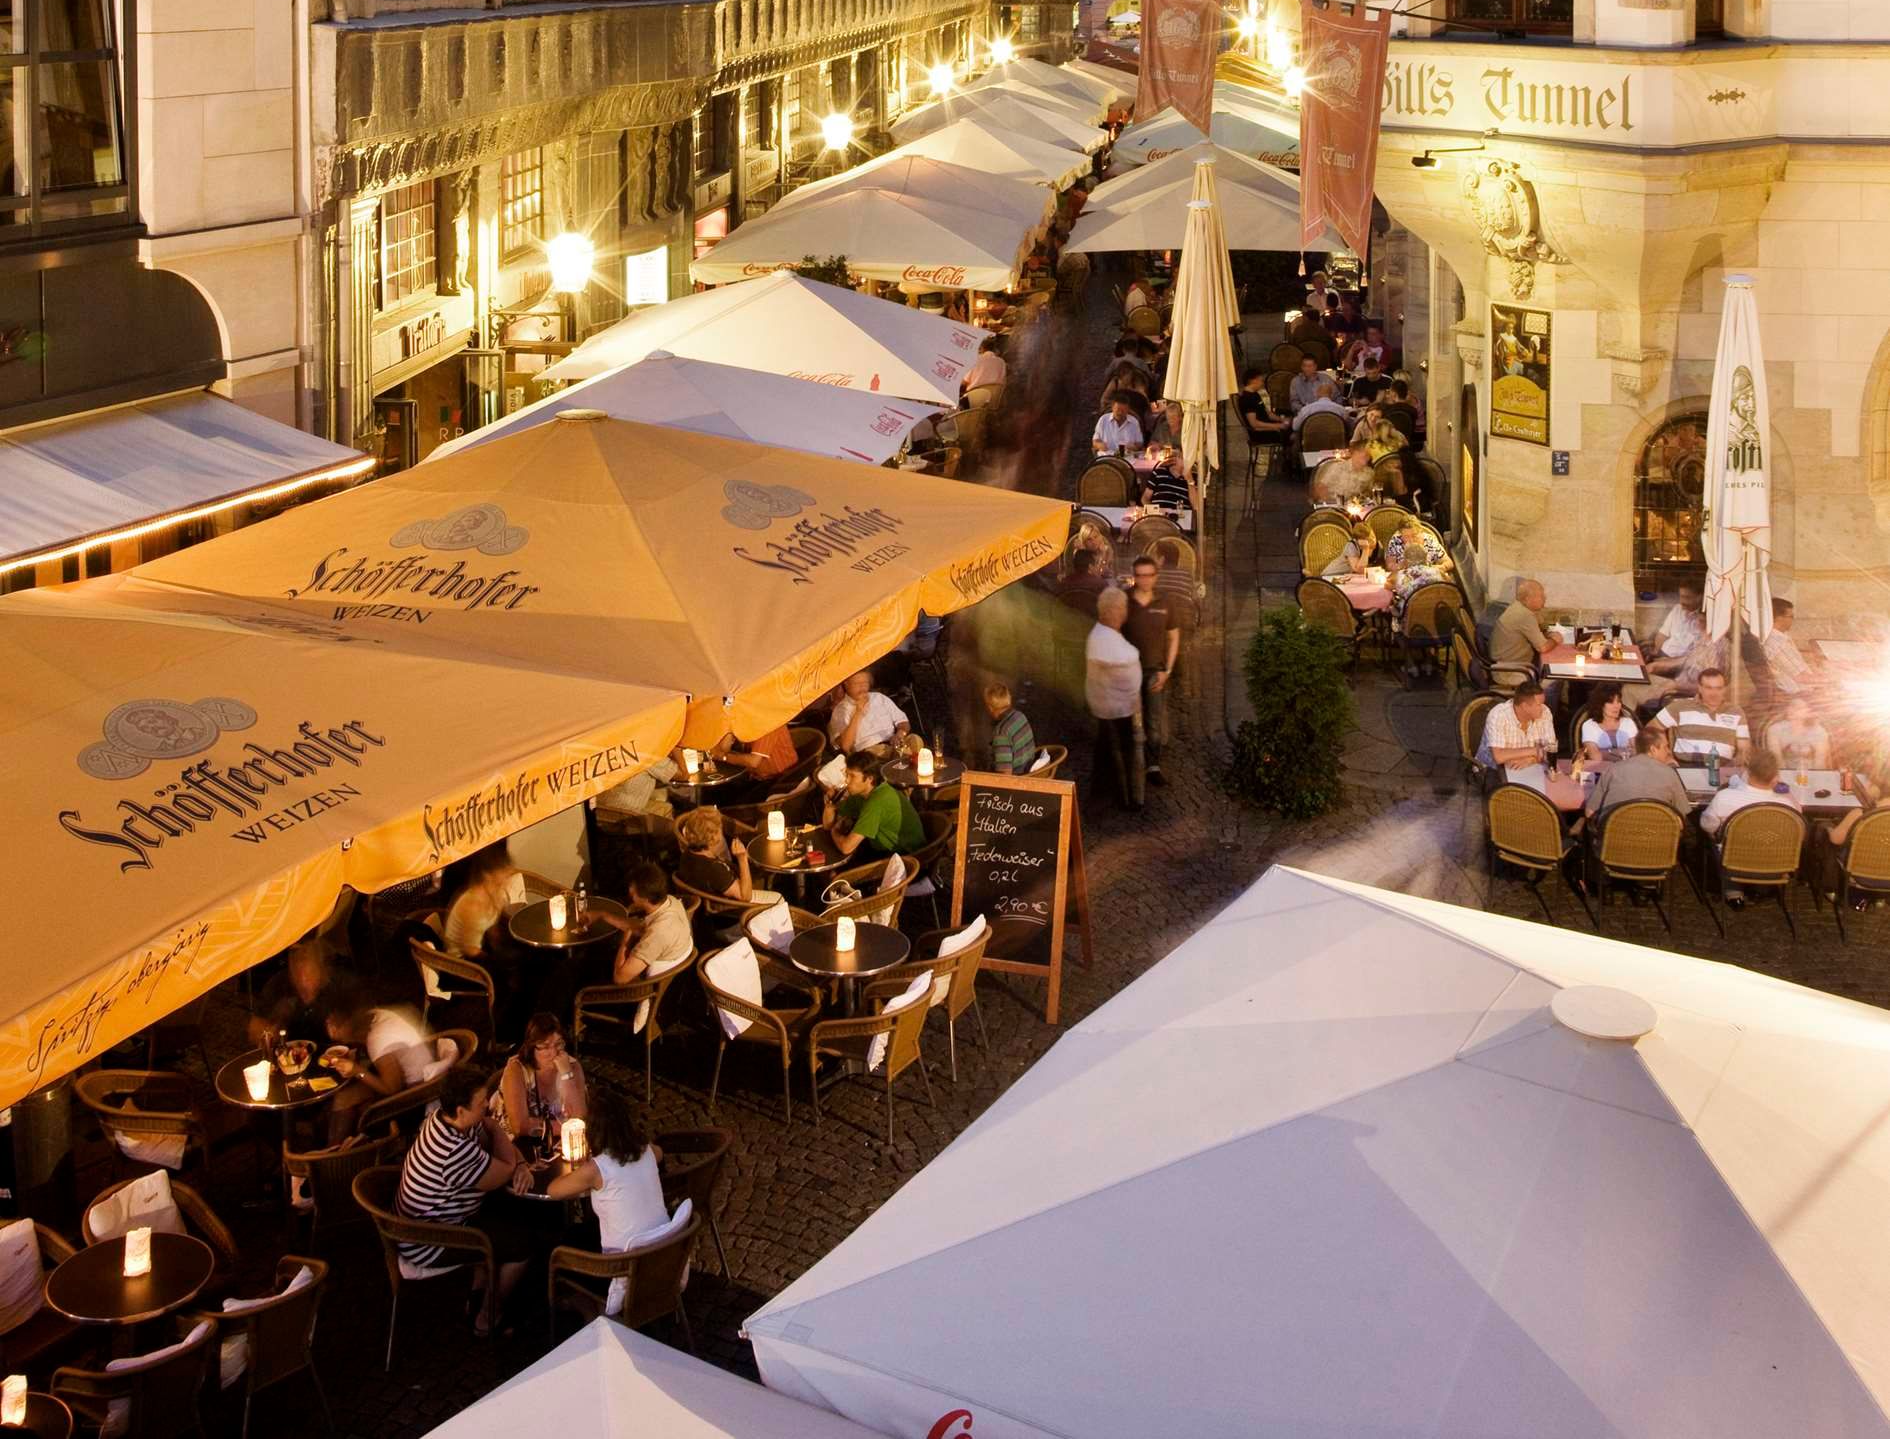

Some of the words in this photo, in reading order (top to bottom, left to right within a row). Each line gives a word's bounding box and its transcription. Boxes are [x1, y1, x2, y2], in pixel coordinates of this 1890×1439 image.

[1479, 64, 1636, 132] Tunnel
[902, 264, 967, 286] Coca-Cola
[733, 505, 905, 586] Schöfferhofer
[851, 540, 912, 575] WEIZEN
[1001, 535, 1054, 573] WEIZEN
[284, 547, 541, 611] Schöfferhofer
[332, 603, 433, 625] WEIZEN
[57, 719, 387, 874] Schöfferhofer
[229, 782, 362, 846] WEIZEN
[423, 772, 540, 865] Schöfferhofer
[545, 739, 641, 796] WEIZEN
[976, 793, 1014, 813] Frisch
[1019, 803, 1045, 818] aus
